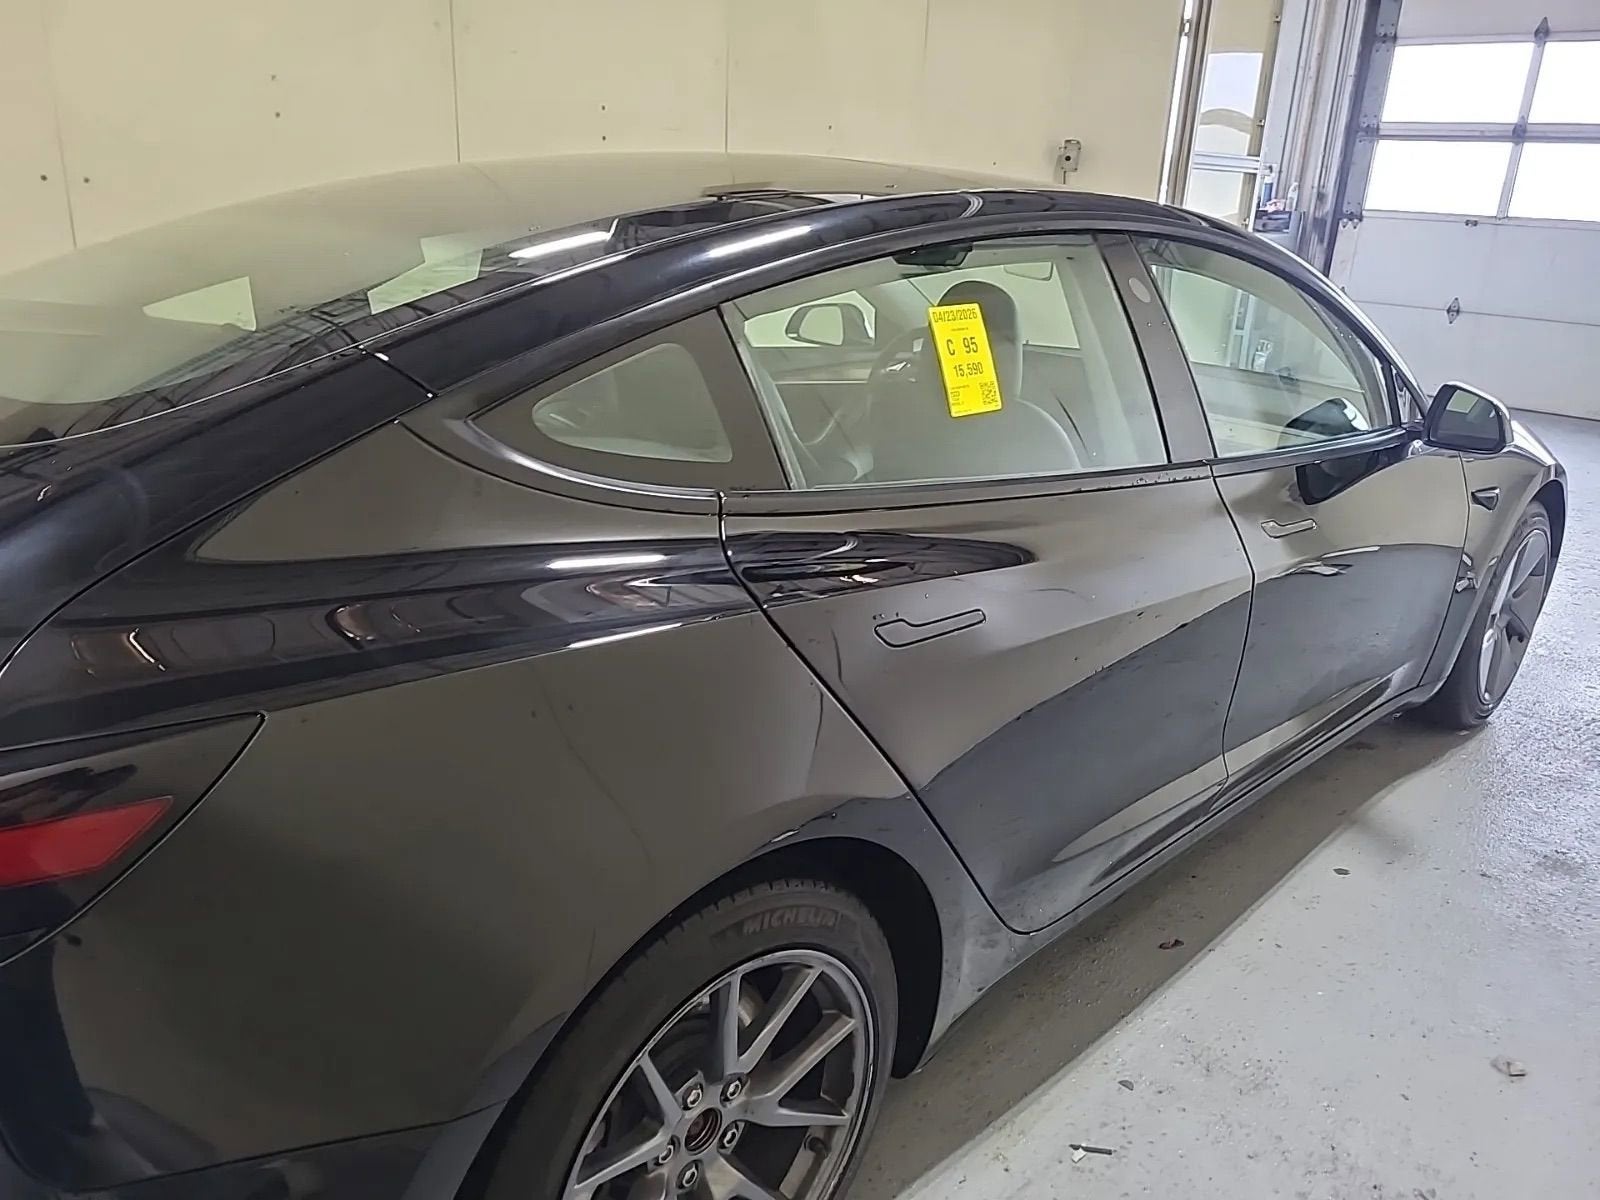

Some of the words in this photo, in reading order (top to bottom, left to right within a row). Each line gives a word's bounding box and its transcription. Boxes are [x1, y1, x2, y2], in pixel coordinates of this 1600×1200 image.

[932, 308, 978, 323] 04/23/2026
[946, 339, 956, 356] C
[962, 336, 978, 354] 95
[953, 361, 984, 379] 15,590
[742, 907, 838, 935] MICHELIN
